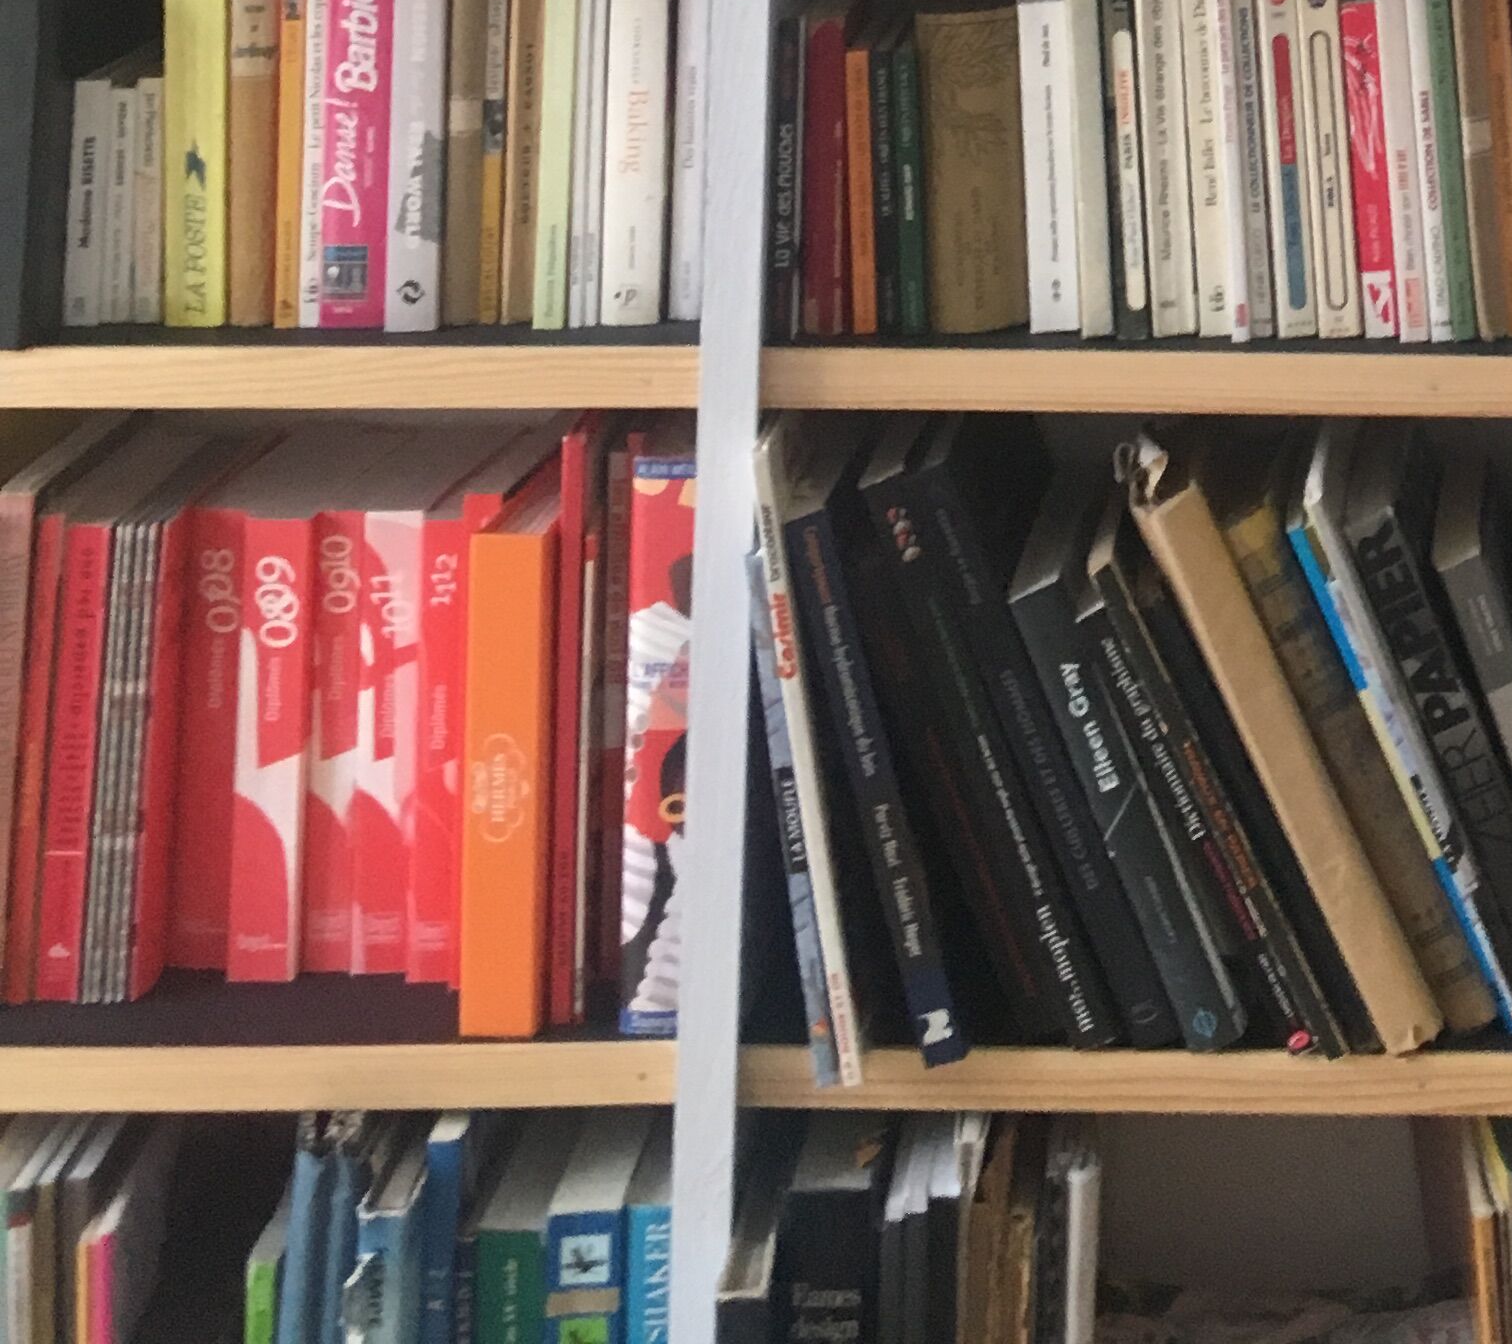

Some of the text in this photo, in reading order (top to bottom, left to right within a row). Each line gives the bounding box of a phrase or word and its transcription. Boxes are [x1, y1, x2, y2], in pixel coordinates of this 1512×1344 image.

[1154, 25, 1165, 49] des
[1197, 20, 1208, 35] de
[1238, 6, 1254, 77] COLLECTIONS
[1201, 108, 1213, 124] Le
[1243, 79, 1255, 99] DE
[320, 98, 362, 227] Danse!
[408, 121, 427, 172] REAL
[620, 89, 650, 175] Baking
[1122, 133, 1134, 170] PARIS
[1245, 101, 1262, 199] COLLECTIONNEUR
[405, 175, 425, 250] WORLD
[1202, 170, 1218, 208] René
[1418, 89, 1447, 308] ITALO CALVINO COLLECTION DE SABLE
[184, 193, 207, 314] LA POSTE
[1160, 209, 1173, 261] Maurice
[81, 546, 97, 580] one
[758, 504, 798, 680] Casimir brocanteur
[76, 589, 96, 620] red
[1354, 519, 1473, 737] PAPIER
[264, 656, 283, 723] Diplômés
[1056, 660, 1122, 793] Eileen Gray
[1099, 635, 1208, 841] Dictionnaire du graphisme
[779, 777, 806, 863] LA MOUFLE
[872, 803, 896, 840] Parviz
[890, 875, 917, 922] Frédéric
